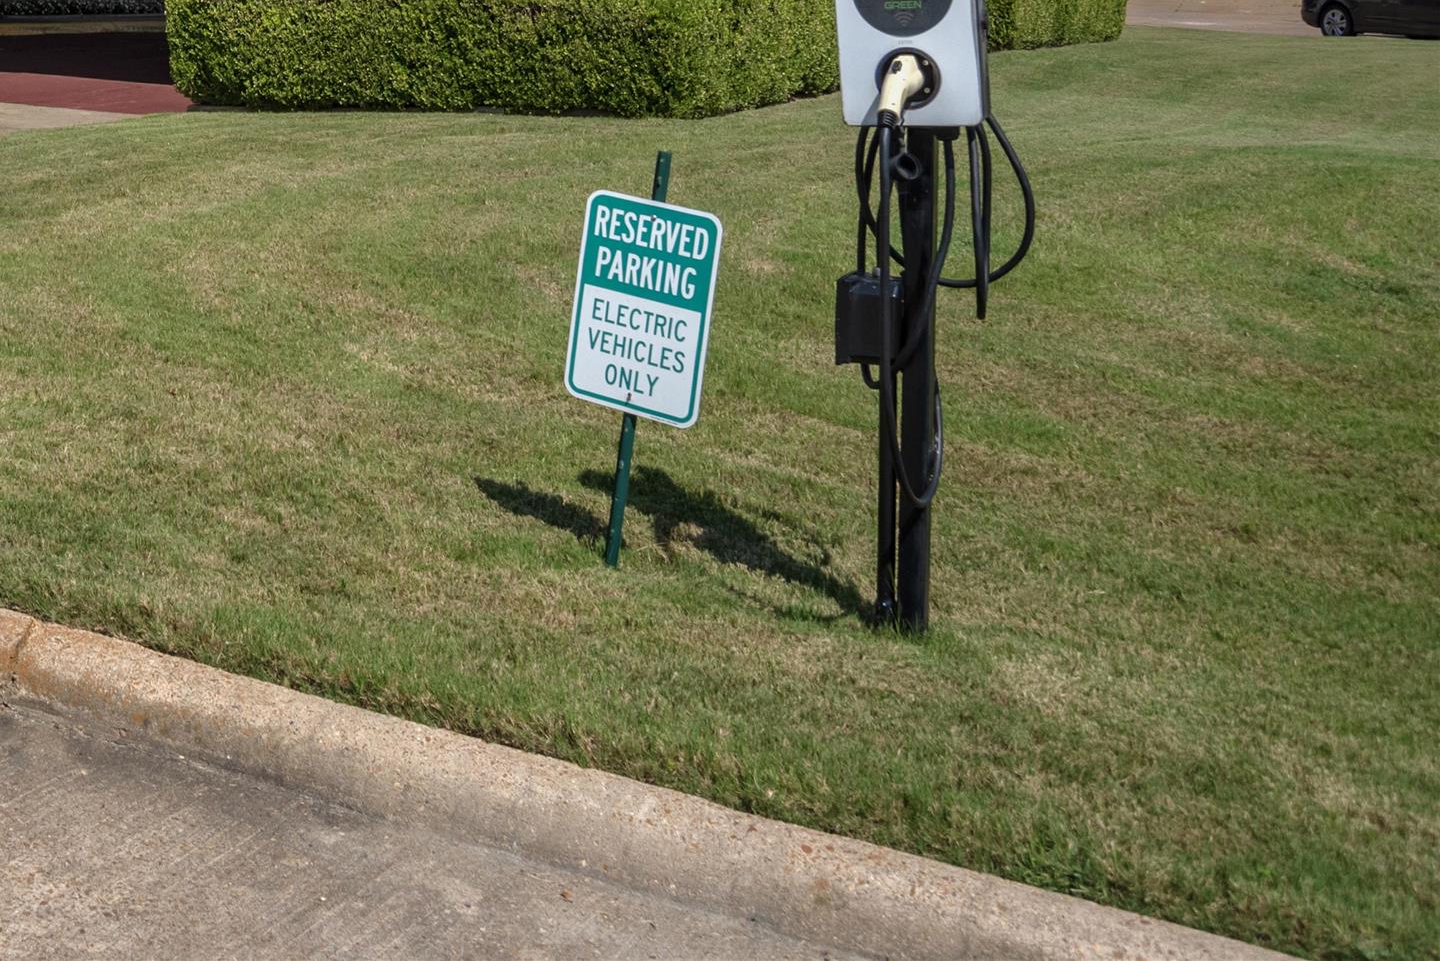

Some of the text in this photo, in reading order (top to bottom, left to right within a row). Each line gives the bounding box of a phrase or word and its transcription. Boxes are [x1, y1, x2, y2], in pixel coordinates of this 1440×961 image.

[883, 0, 922, 10] GREEN
[593, 204, 709, 261] RESERVED
[594, 246, 697, 300] PARKING
[591, 298, 688, 343] ELECTRIC
[588, 327, 686, 374] VEHICLES
[604, 363, 660, 397] ONLY
